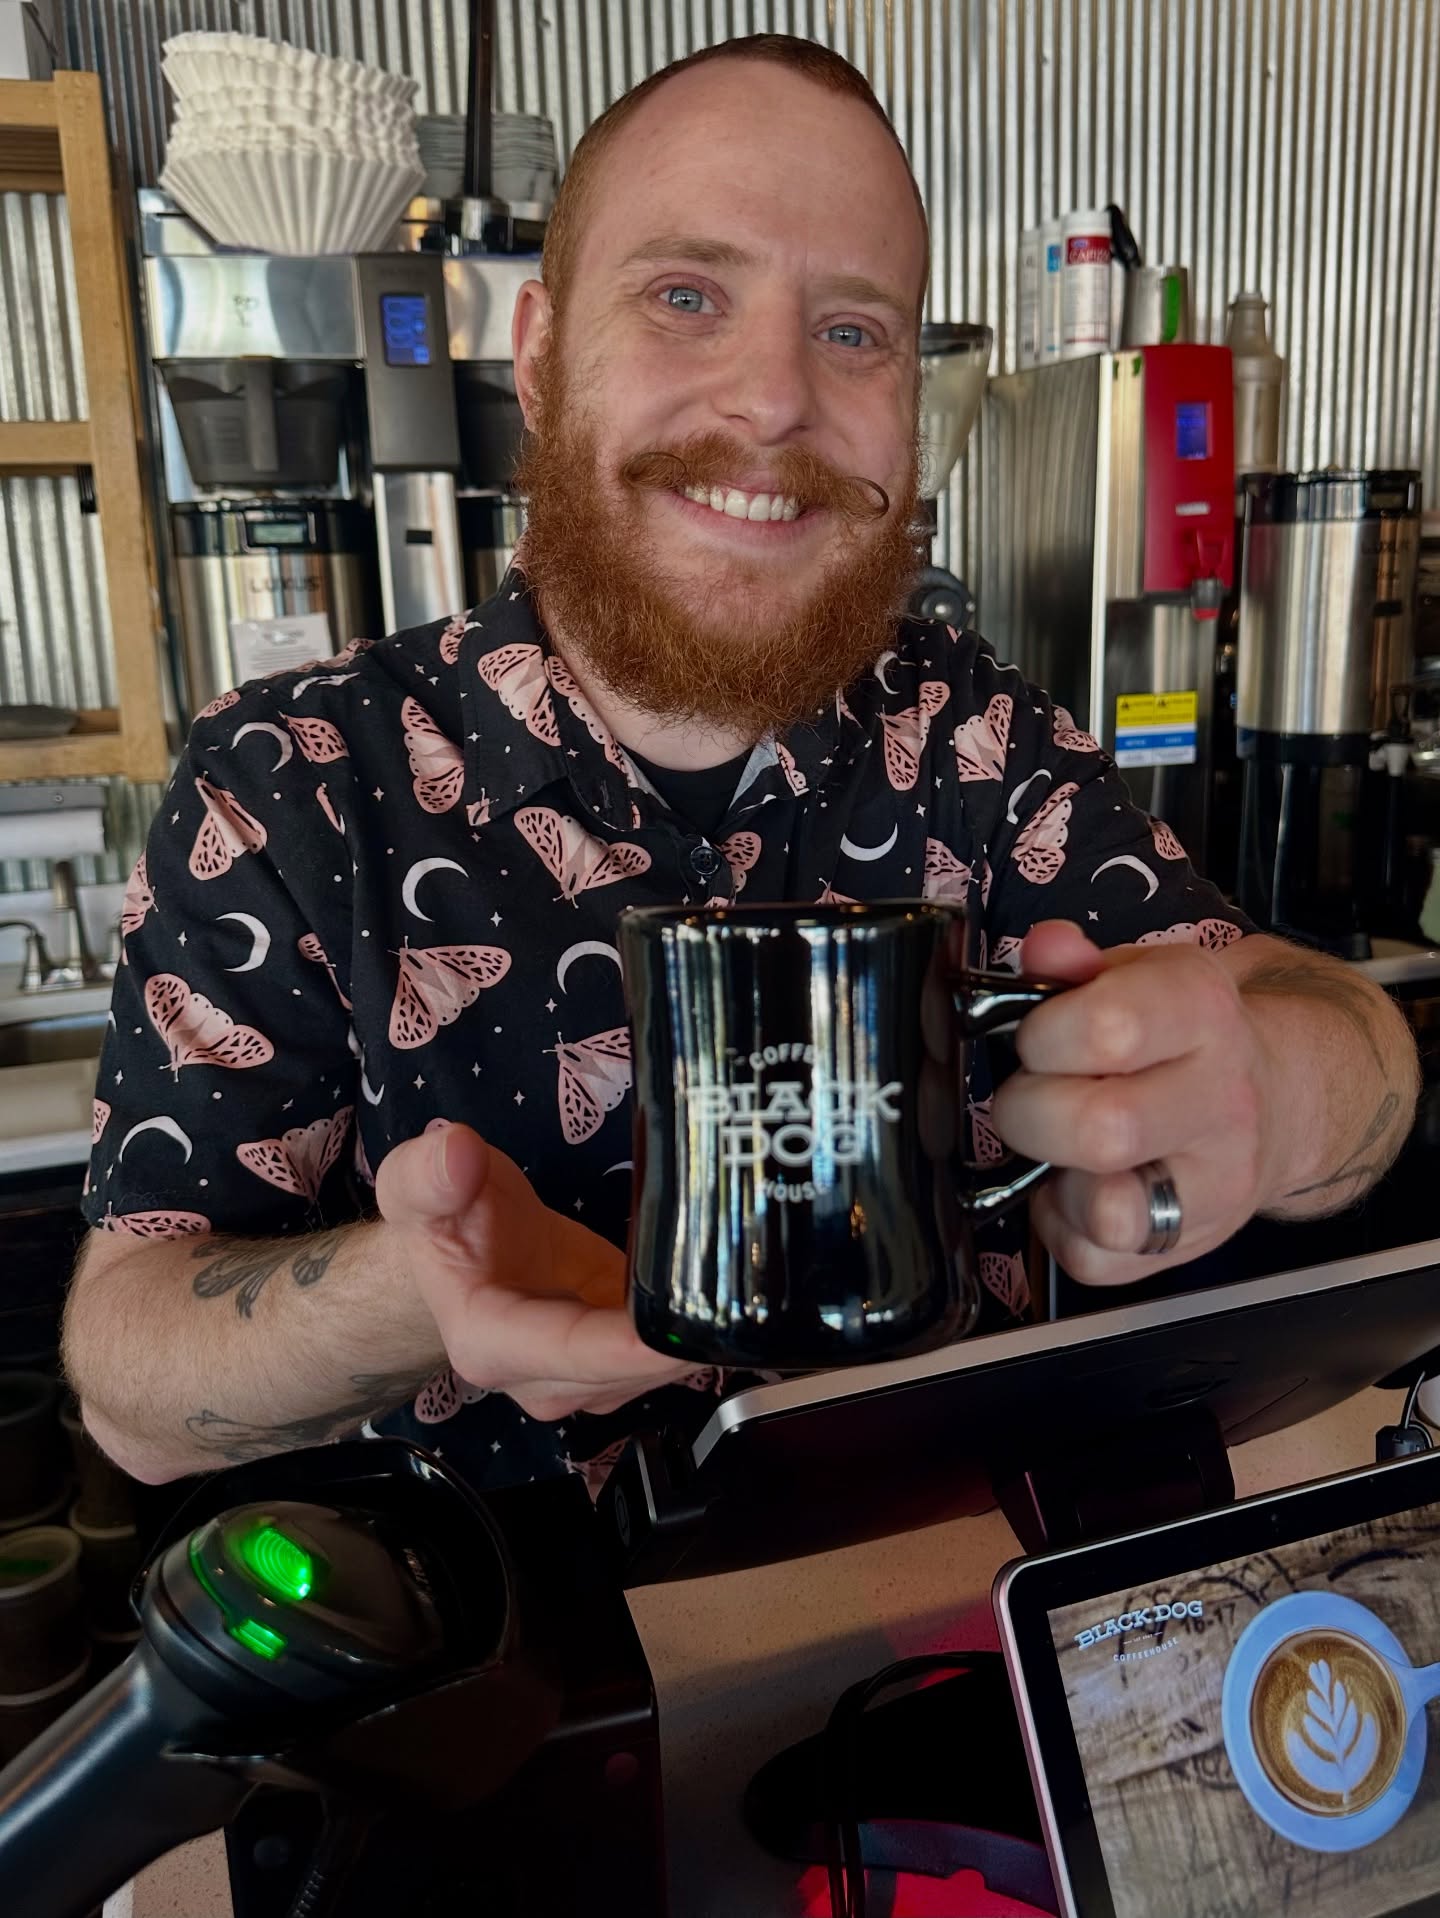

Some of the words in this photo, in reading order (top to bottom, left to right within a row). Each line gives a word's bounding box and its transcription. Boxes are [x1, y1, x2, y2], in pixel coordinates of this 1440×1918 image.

[749, 1041, 832, 1072] COFFE
[720, 1122, 867, 1167] DOG
[1073, 1607, 1152, 1651] BLACK
[1151, 1599, 1203, 1623] DOG
[1113, 1636, 1178, 1662] COFFEEHOUSE
